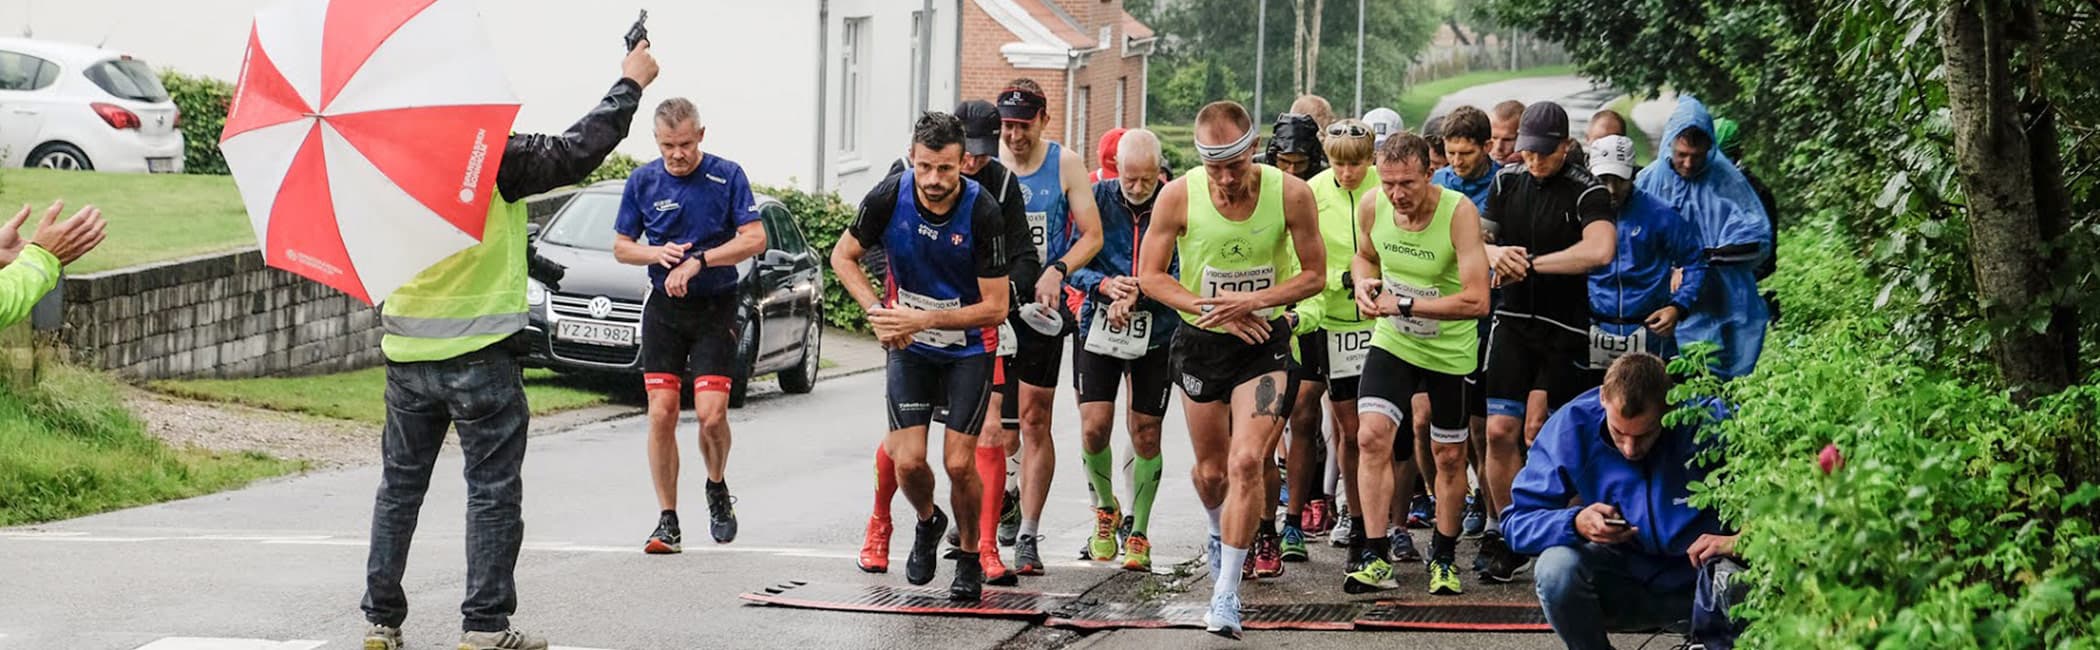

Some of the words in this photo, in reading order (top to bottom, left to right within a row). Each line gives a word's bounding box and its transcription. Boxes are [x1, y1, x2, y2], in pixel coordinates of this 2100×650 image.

[946, 300, 958, 308] KM
[562, 323, 580, 336] YZ
[583, 325, 598, 339] 21
[603, 328, 630, 342] 982
[1335, 331, 1372, 352] 102
